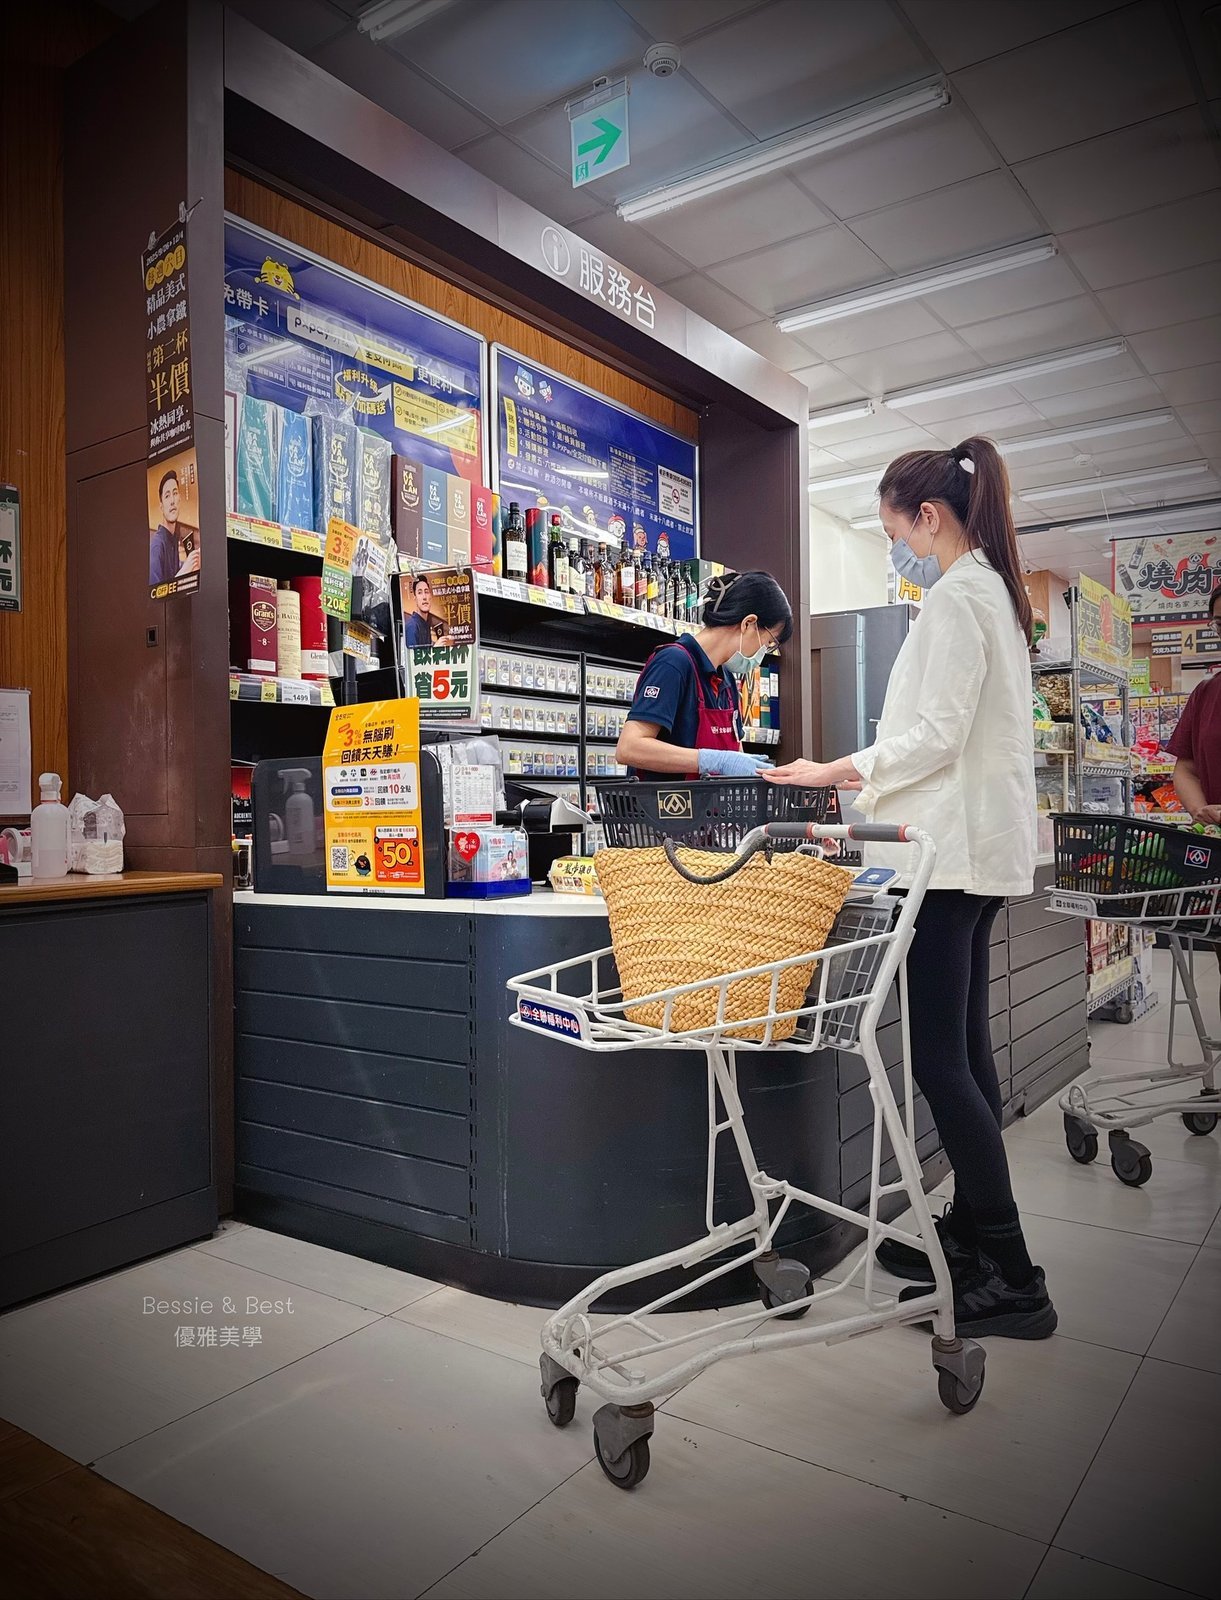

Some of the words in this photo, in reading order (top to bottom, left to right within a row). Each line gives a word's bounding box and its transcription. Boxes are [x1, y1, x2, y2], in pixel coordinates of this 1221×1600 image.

[147, 272, 186, 316] 精品美式
[580, 247, 656, 329] 服務台
[147, 300, 187, 340] 小農拿鐵
[153, 328, 188, 369] 第二杯
[149, 356, 190, 411] 半價
[342, 369, 379, 393] 福利升級
[263, 536, 280, 545] 1999
[302, 545, 319, 553] 1999
[253, 608, 275, 618] Grant's
[443, 603, 471, 625] 半價
[1184, 633, 1194, 650] 4
[413, 645, 470, 666] 飲料杯
[414, 670, 468, 700] 省5元
[293, 694, 309, 702] 1499
[362, 725, 395, 744] 無腦刷
[382, 841, 411, 869] 50
[532, 1006, 580, 1034] 全聯福利中心
